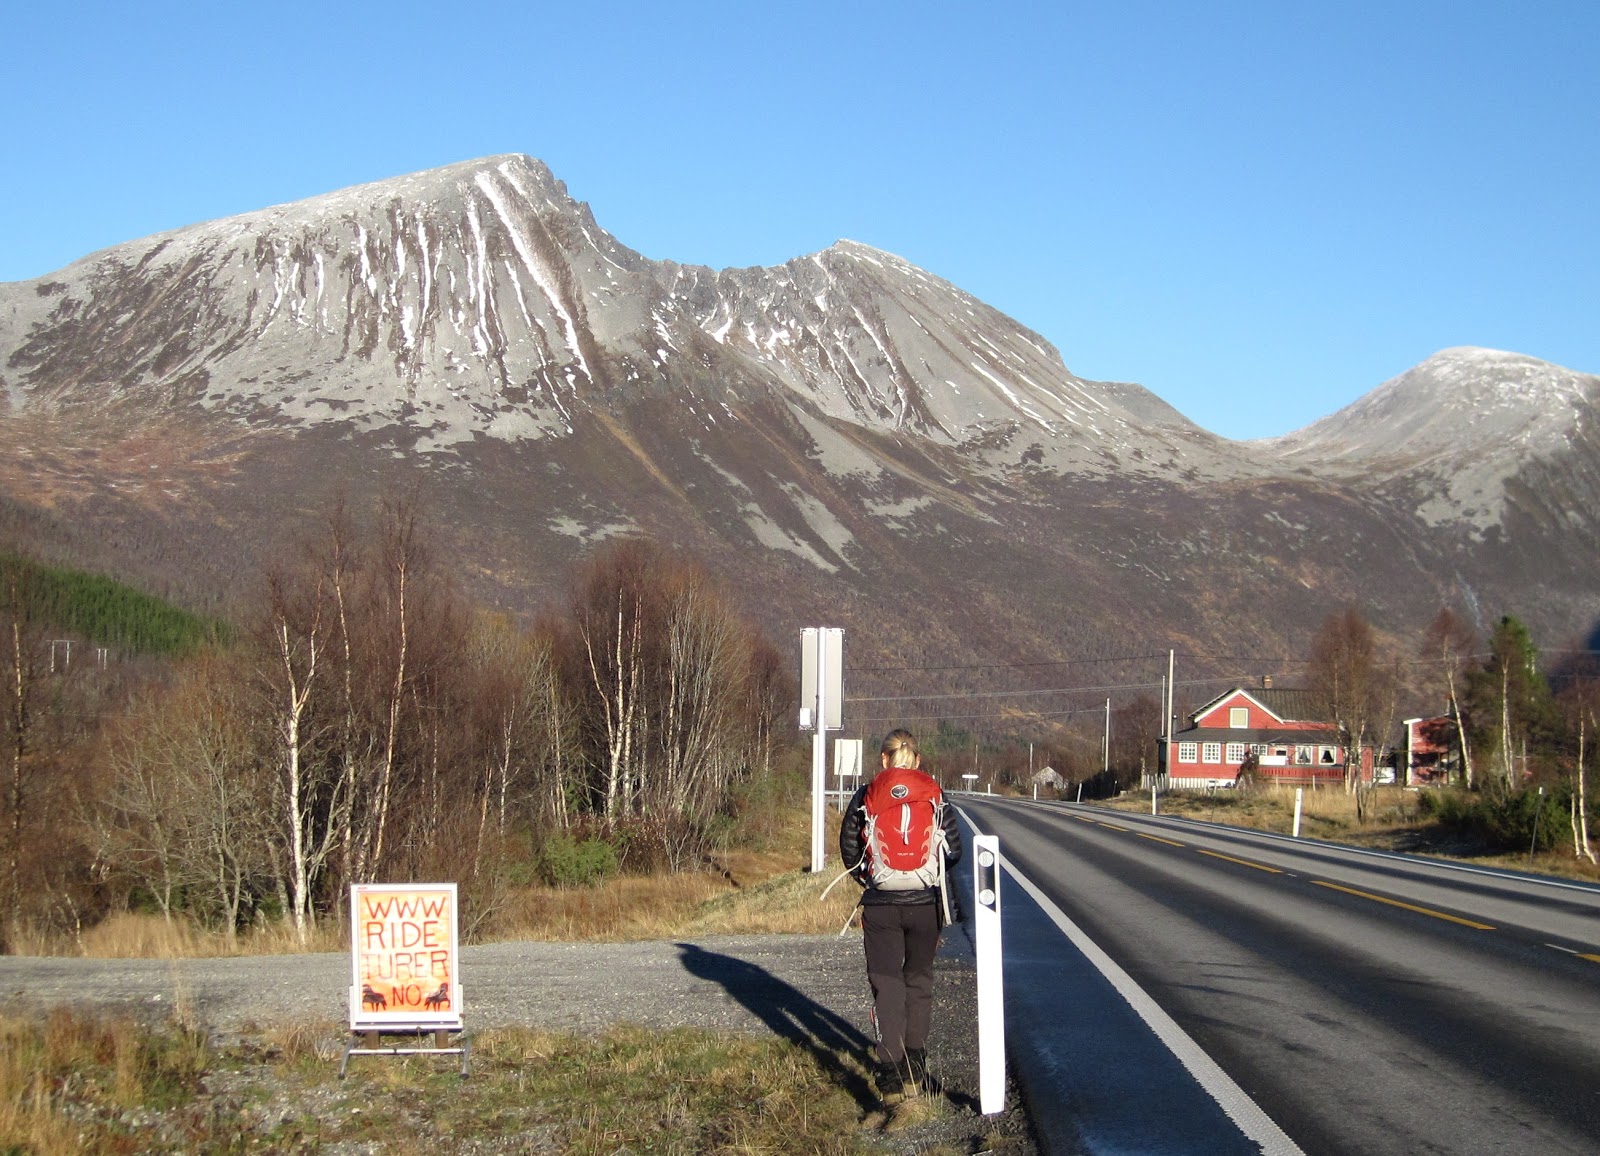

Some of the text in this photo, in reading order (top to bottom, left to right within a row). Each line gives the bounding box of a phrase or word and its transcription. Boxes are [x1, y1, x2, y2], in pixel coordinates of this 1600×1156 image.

[365, 896, 446, 919] WWW
[366, 920, 439, 949] RIDE
[361, 950, 449, 980] TURER
[392, 984, 422, 1007] NO
